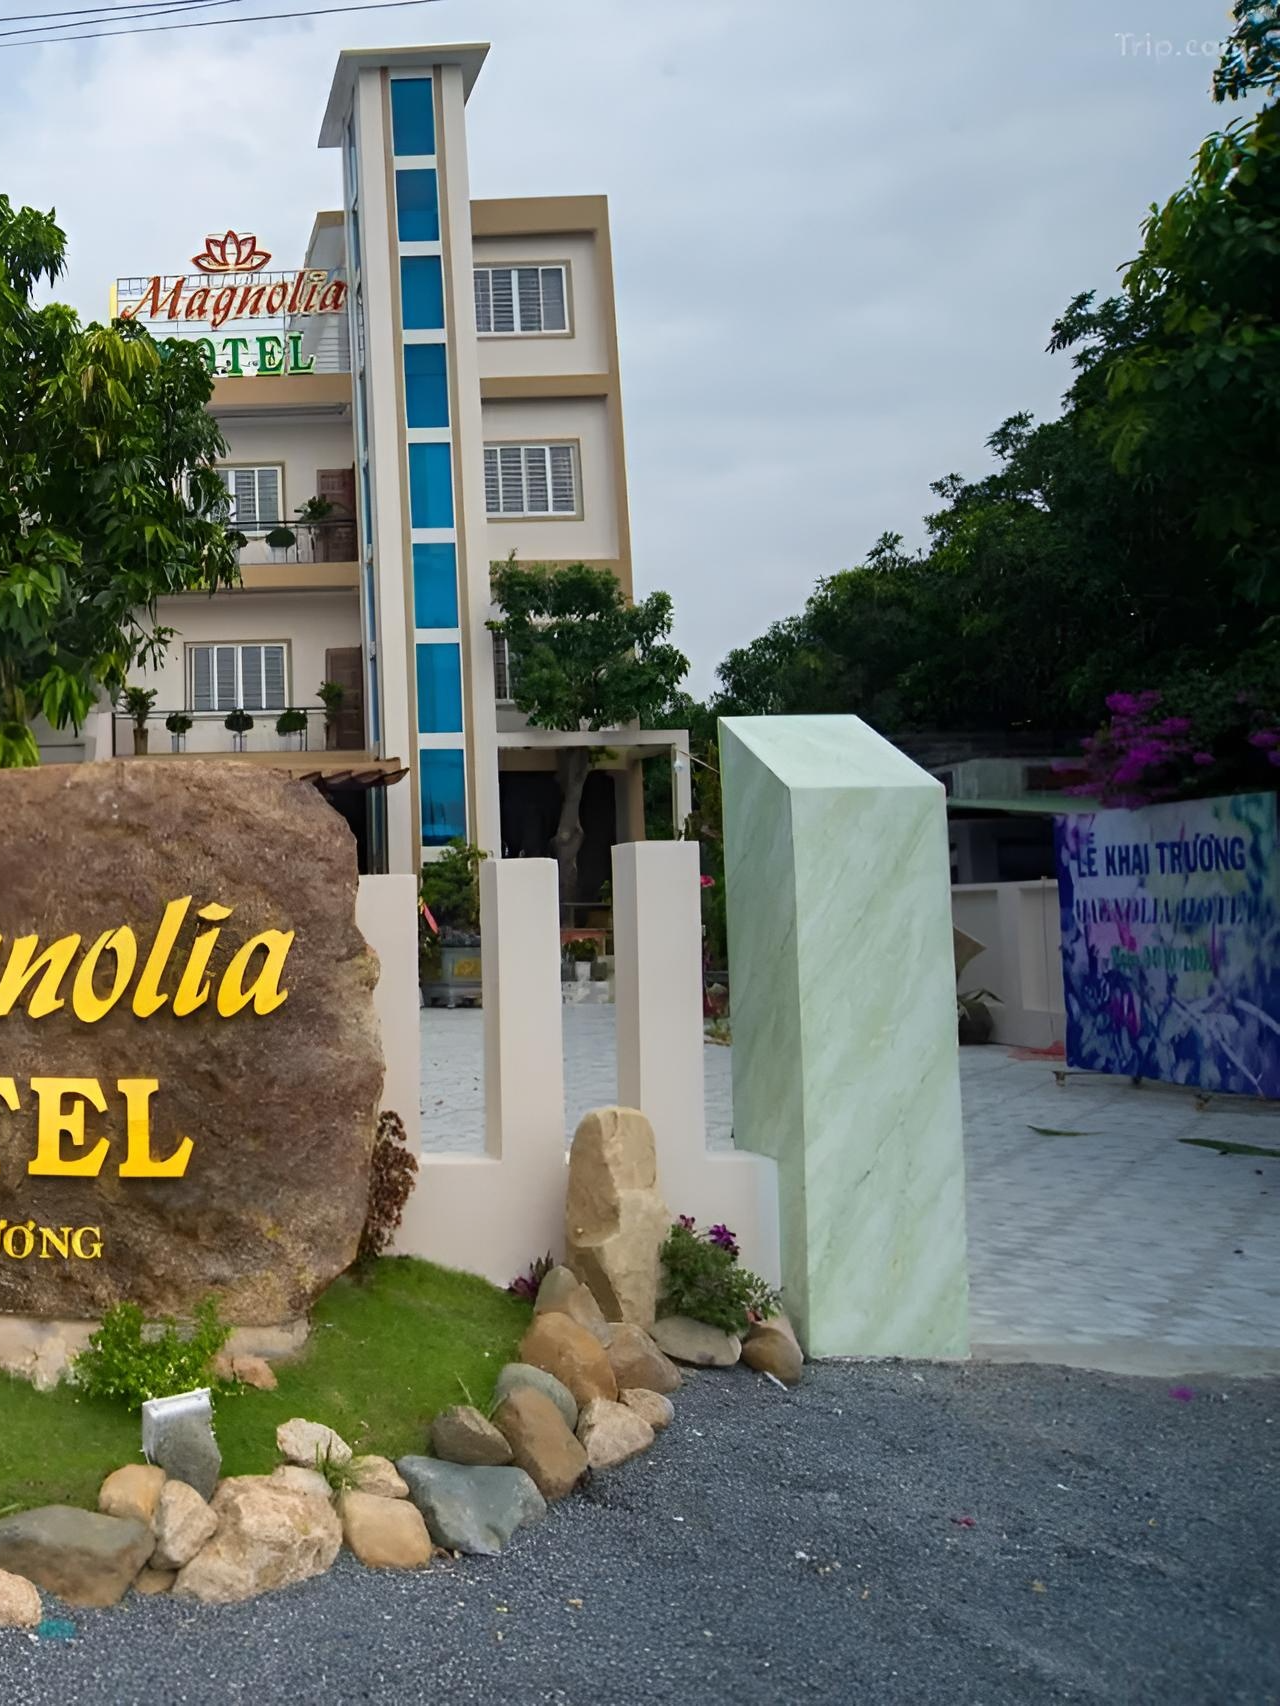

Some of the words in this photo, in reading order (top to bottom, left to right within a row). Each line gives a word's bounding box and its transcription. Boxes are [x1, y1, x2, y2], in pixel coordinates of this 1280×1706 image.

[120, 271, 348, 331] Magnolia
[194, 331, 315, 377] OTEL
[1105, 841, 1150, 877] KHAI
